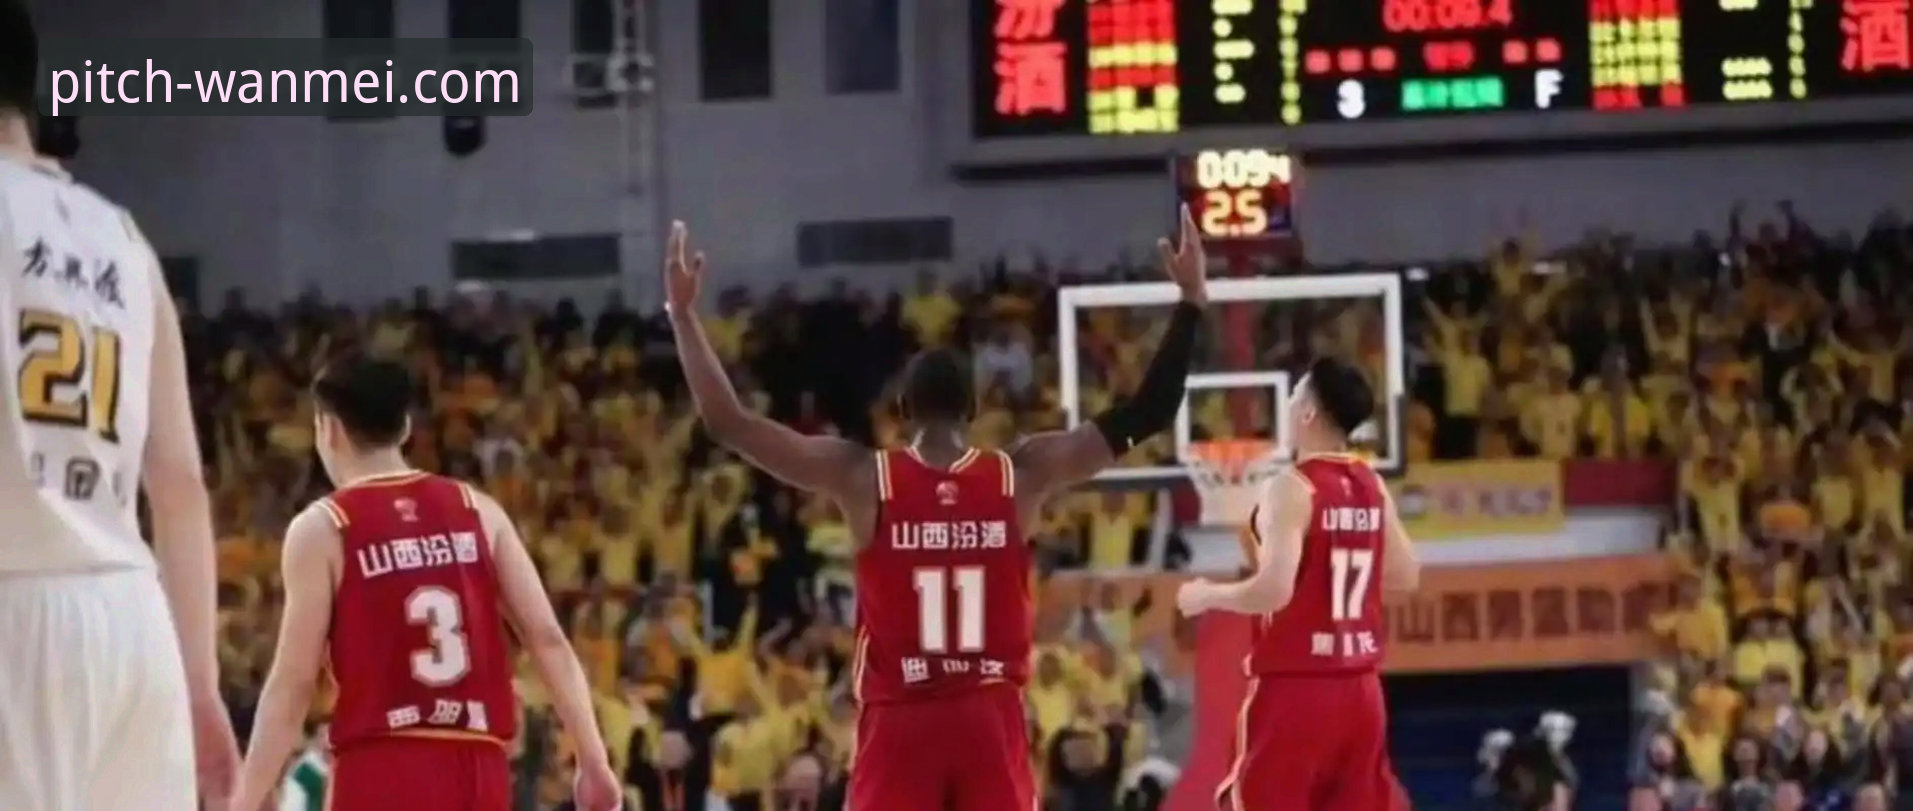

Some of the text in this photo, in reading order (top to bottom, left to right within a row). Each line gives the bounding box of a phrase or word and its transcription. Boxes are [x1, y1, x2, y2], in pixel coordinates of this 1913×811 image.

[18, 307, 119, 444] 21
[891, 520, 1008, 550] 山西汾酒
[913, 566, 986, 653] 11
[1330, 549, 1374, 620] 17
[404, 584, 471, 687] 3
